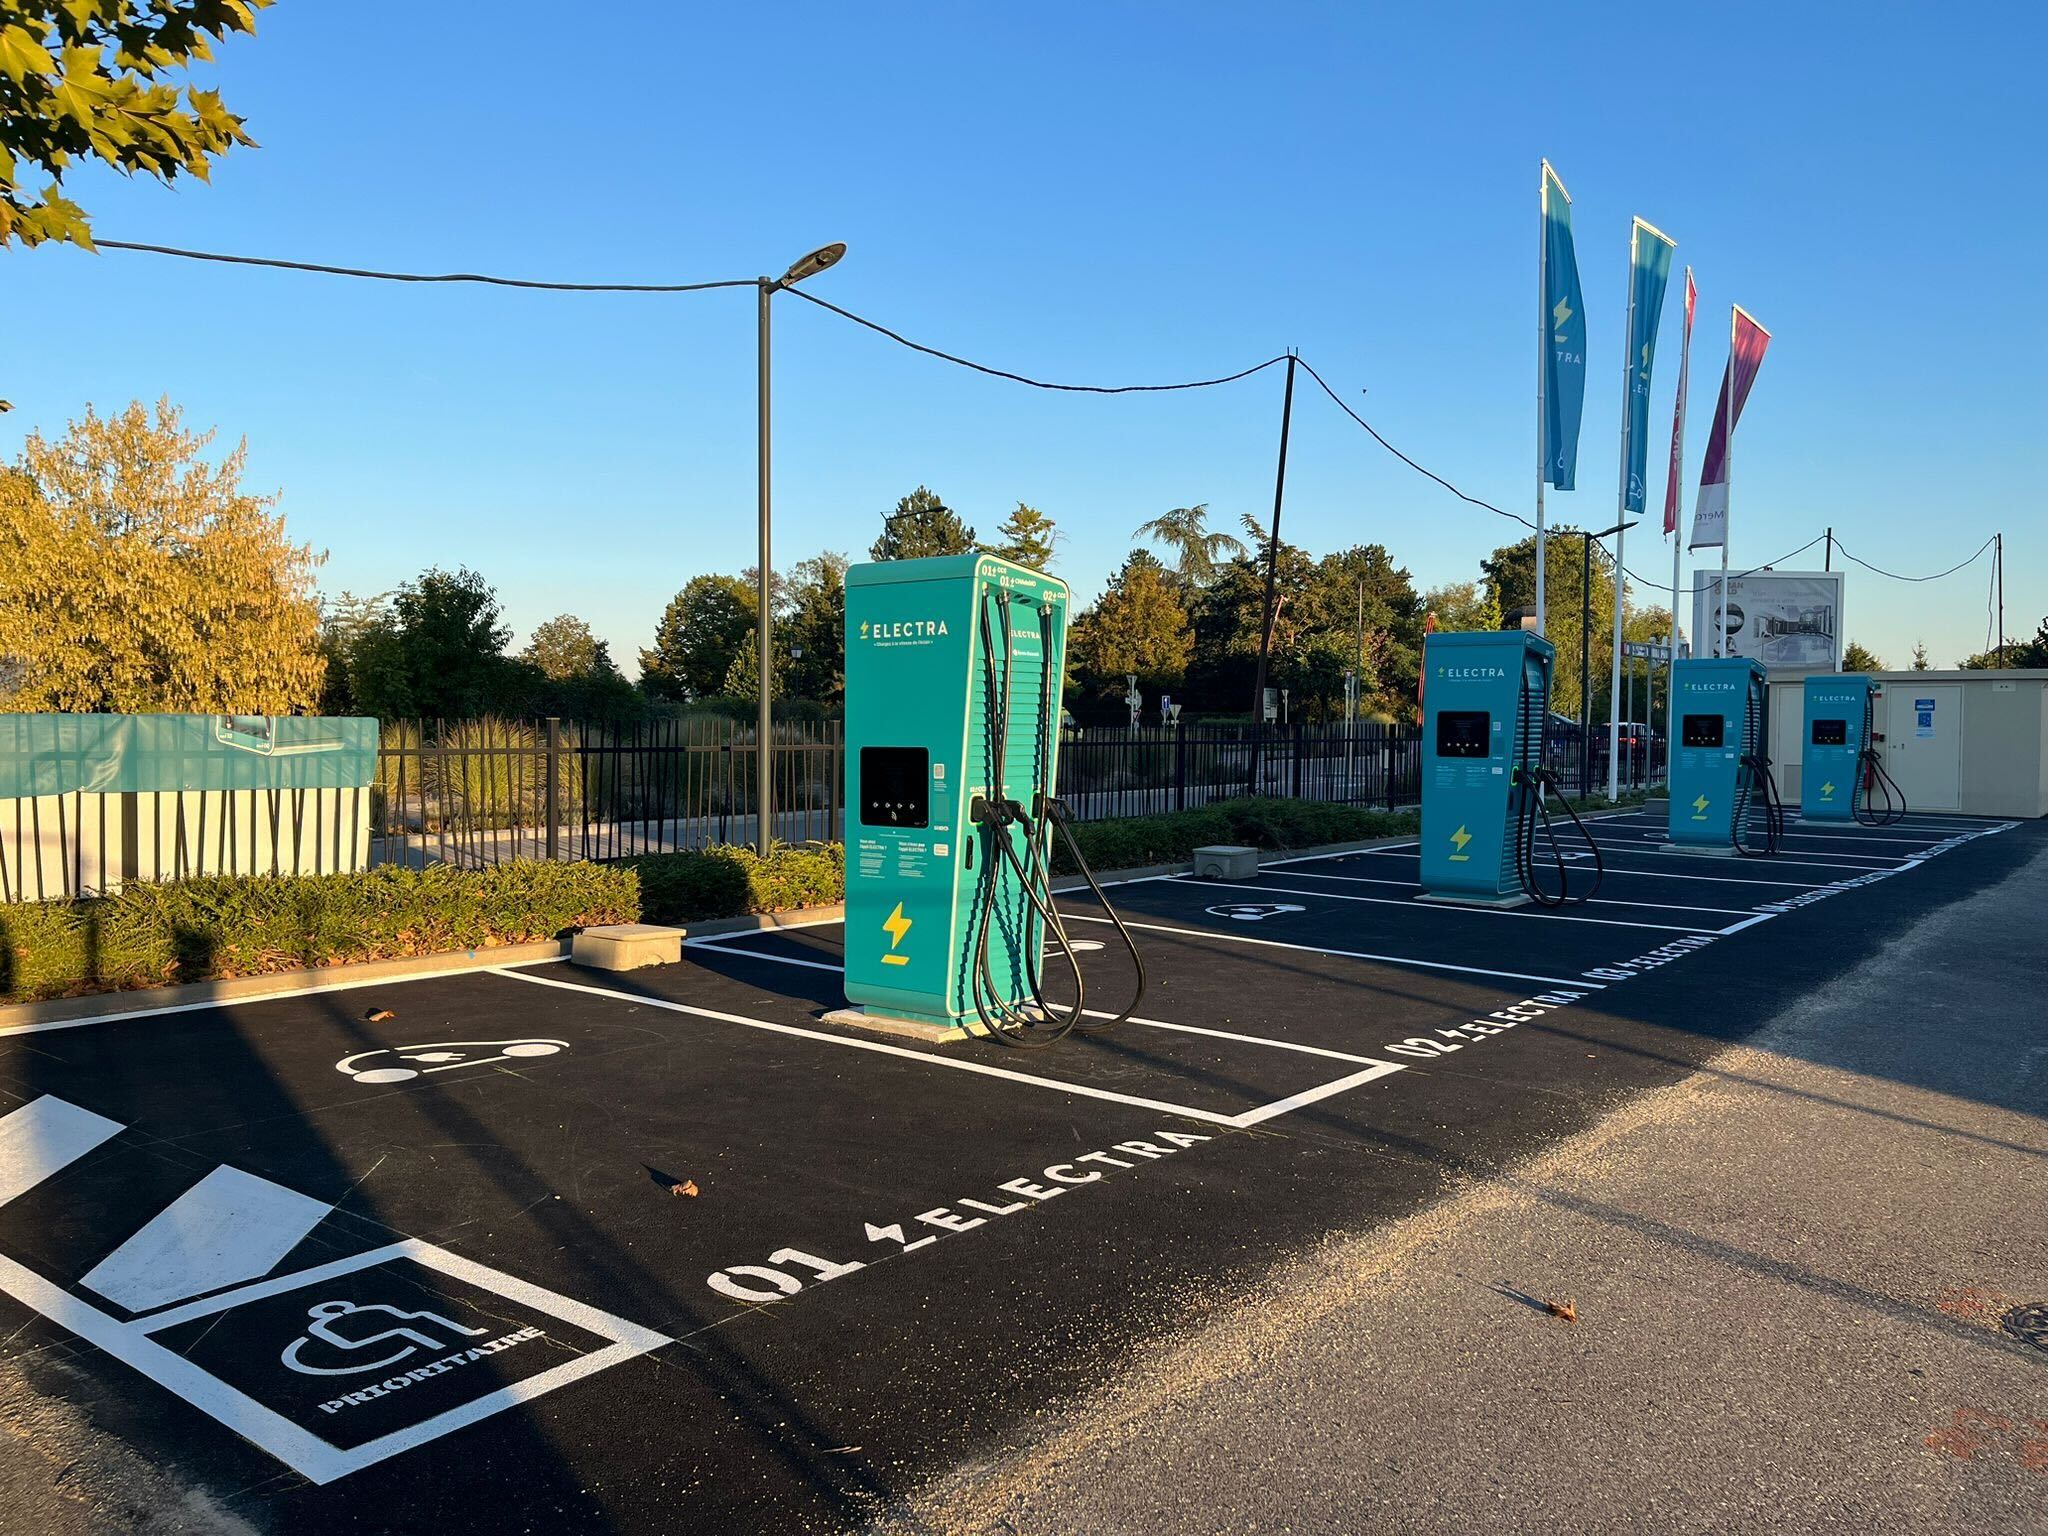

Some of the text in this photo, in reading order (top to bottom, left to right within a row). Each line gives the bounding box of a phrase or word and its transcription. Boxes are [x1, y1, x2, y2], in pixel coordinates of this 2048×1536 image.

[981, 565, 992, 577] 01
[1000, 576, 1010, 587] 01
[1042, 590, 1054, 601] 02
[873, 620, 948, 638] ELECTRA
[1448, 668, 1505, 677] ELECTRA
[1691, 683, 1736, 691] ELECTRA
[1581, 935, 1719, 981] 03 ELECTRA
[1384, 990, 1589, 1058] 02 ELECTRA
[706, 1129, 1213, 1302] 01 ELECTRA
[317, 1325, 546, 1414] PRIORITAIRE
